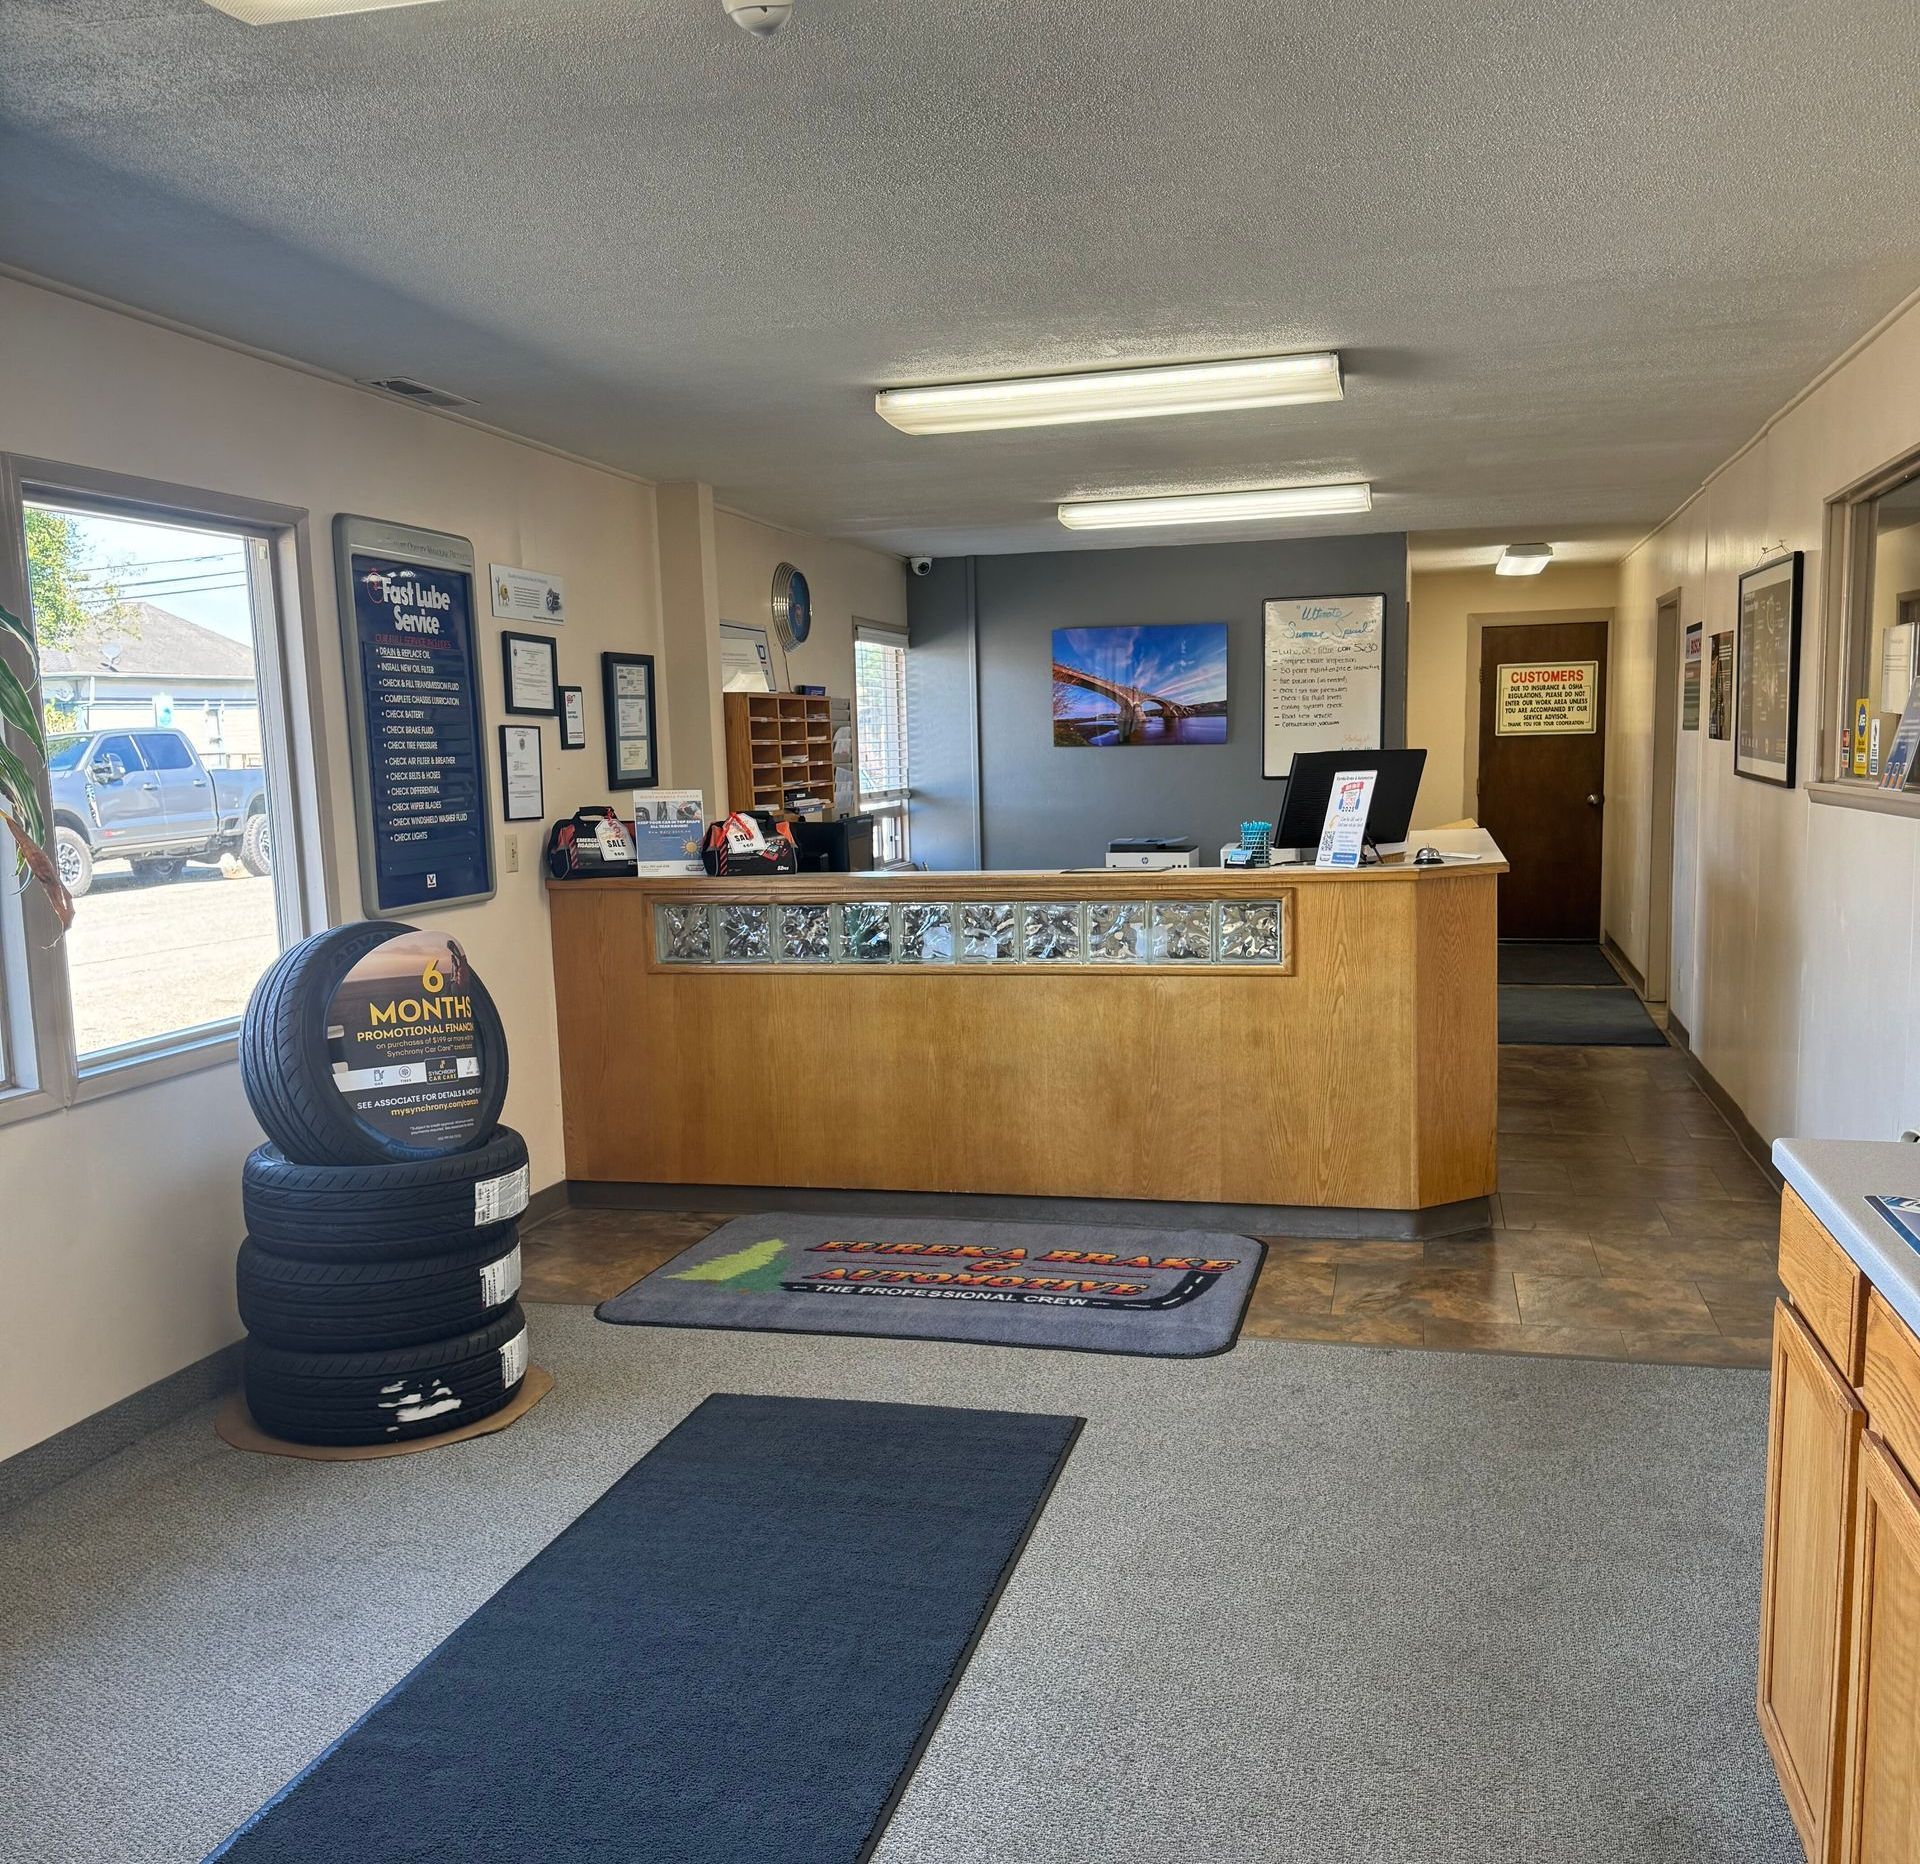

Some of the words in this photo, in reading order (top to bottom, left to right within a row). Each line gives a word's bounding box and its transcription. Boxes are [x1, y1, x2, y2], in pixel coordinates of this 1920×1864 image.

[380, 577, 414, 606] Fast
[416, 582, 450, 610] Lube
[393, 605, 440, 634] Service
[380, 646, 396, 656] DRAIN
[396, 648, 401, 657] &
[402, 649, 422, 658] REPLACE
[422, 650, 431, 659] OIL
[381, 662, 400, 672] INSTALL
[400, 664, 412, 672] NEW
[412, 665, 421, 673] OIL
[421, 665, 434, 674] FILTER
[1511, 669, 1584, 684] CUSTOMERS
[382, 678, 401, 688] CHECK
[406, 679, 415, 688] FILL
[415, 680, 448, 690] TRANSMISSION
[448, 682, 460, 691] FLUID
[384, 694, 411, 704] COMPLETE
[411, 695, 431, 704] CHASSIS
[432, 696, 460, 706] LUBRICATION
[385, 710, 404, 718] CHECK
[405, 710, 424, 719] BATTERY
[386, 725, 405, 734] CHECK
[405, 726, 420, 734] BRAKE
[421, 726, 434, 735] FLUID
[387, 741, 406, 750] CHECK
[406, 741, 416, 749] TIRE
[416, 741, 438, 750] PRESSURE
[389, 757, 407, 766] CHECK
[407, 757, 416, 765] AIR
[416, 757, 430, 765] FILTER
[431, 757, 435, 765] &
[435, 756, 456, 765] BREATHER
[390, 772, 408, 780] CHECK
[409, 771, 421, 780] BELTS
[421, 771, 426, 779] &
[425, 771, 441, 779] HOSES
[391, 787, 410, 796] CHECK
[410, 786, 440, 795] DIFFERENTIAL
[392, 802, 410, 812] CHECK
[410, 801, 424, 810] WIPER
[425, 800, 442, 810] BLADES
[393, 818, 411, 827] CHECK
[411, 815, 438, 825] WINDSHIELD
[439, 814, 456, 823] WASHER
[456, 812, 468, 821] FLUID
[393, 833, 411, 842] CHECK
[412, 831, 428, 841] LIGHTS
[607, 840, 626, 848] SALE
[422, 958, 444, 993] 6
[369, 995, 472, 1026] MONTHS
[356, 1024, 444, 1042] PROMOTIONAL
[387, 1040, 424, 1049] purchases
[425, 1037, 432, 1045] of
[432, 1036, 446, 1044] $199
[387, 1049, 423, 1058] Synchrony
[428, 1068, 456, 1076] SYNCHRONY
[357, 1101, 373, 1110] SEE
[374, 1095, 421, 1108] ASSOCIATE
[422, 1092, 437, 1101] FOR
[438, 1089, 461, 1099] DETAILS
[804, 1240, 1028, 1261] EUREKA
[1033, 1248, 1241, 1272] BRAKE
[964, 1260, 1025, 1273] &
[804, 1267, 1150, 1297] AUTOMOTIVE
[814, 1284, 852, 1295] THE
[852, 1286, 1018, 1303] PROFESSIONAL
[1023, 1295, 1088, 1306] CREW
